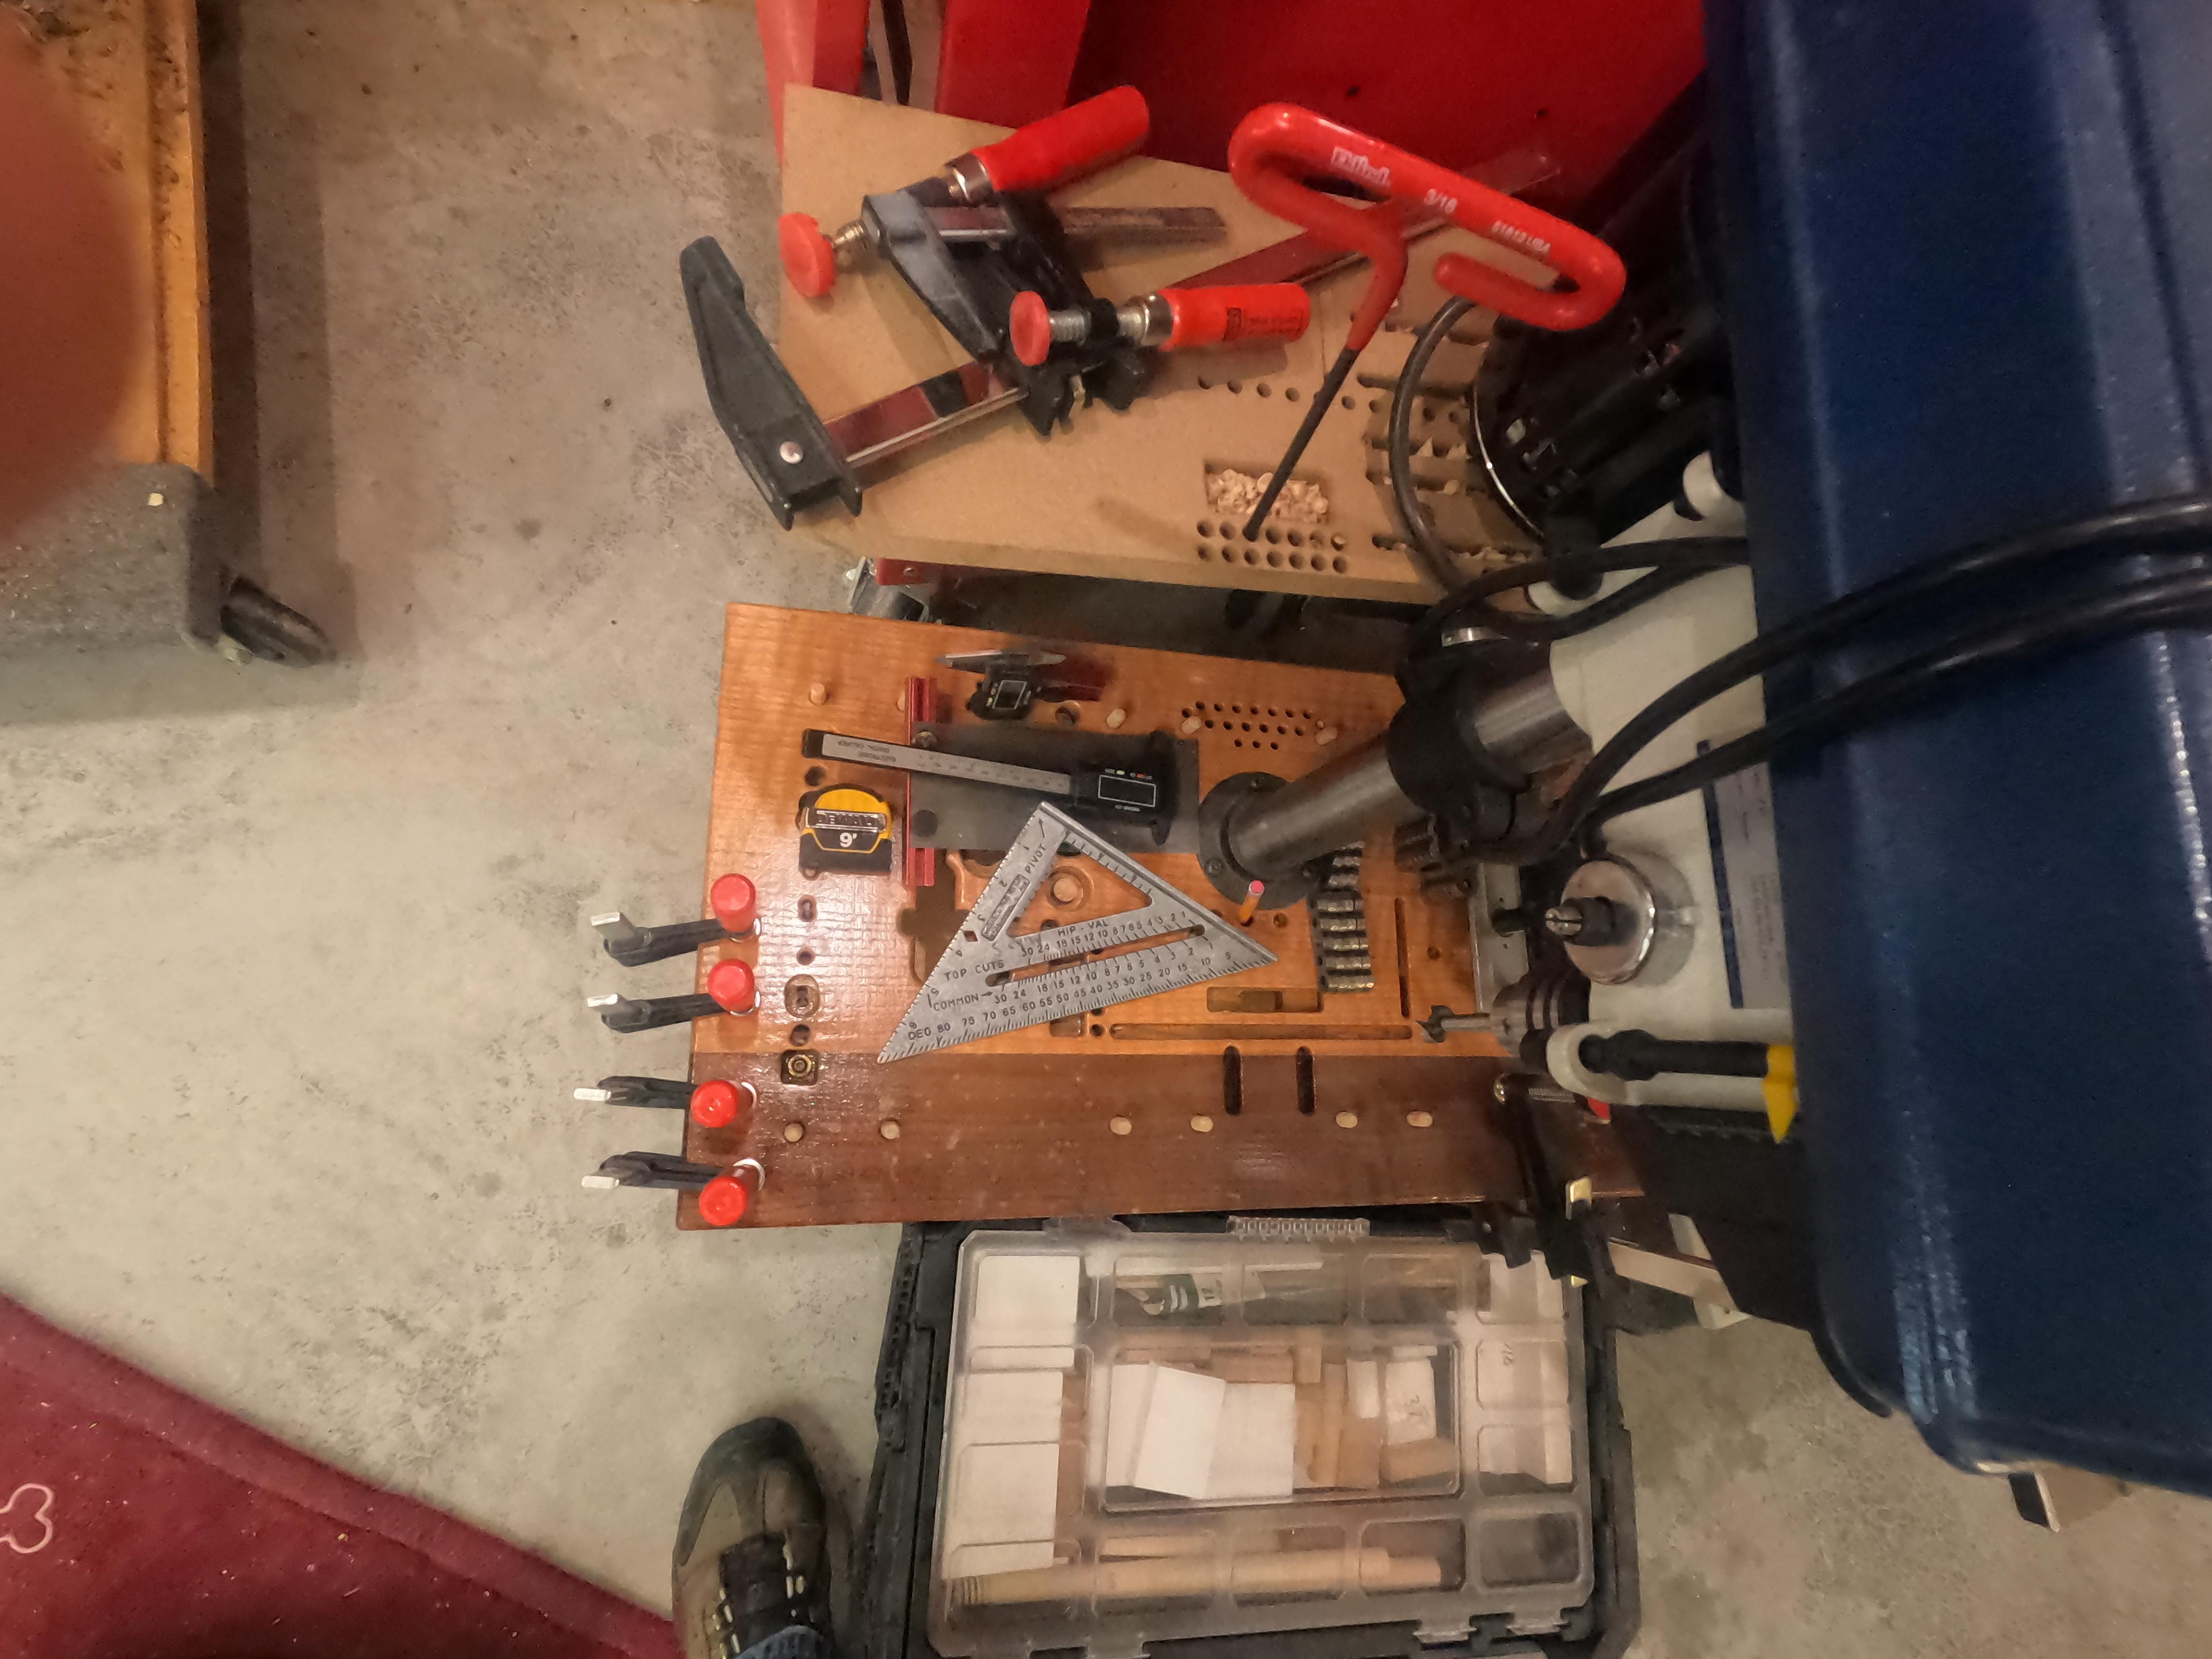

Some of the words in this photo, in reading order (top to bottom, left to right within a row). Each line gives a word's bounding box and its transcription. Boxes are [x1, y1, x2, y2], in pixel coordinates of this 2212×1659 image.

[1025, 843, 1046, 874] PIVOT
[1056, 939, 1068, 949] 18
[1070, 936, 1081, 945] 15
[1083, 932, 1095, 941] 12
[1097, 929, 1108, 938] 10
[1171, 913, 1176, 922] 2
[1058, 926, 1076, 937] HIP
[1087, 919, 1109, 929] VAL
[933, 993, 979, 1011] COMMON
[1013, 989, 1026, 999] 24
[1037, 983, 1048, 994] 18
[1053, 979, 1064, 989] 15
[1070, 975, 1080, 985] 12
[1087, 972, 1097, 981] 10
[1115, 965, 1120, 974] 7
[1139, 959, 1144, 968] 5
[944, 968, 967, 981] TOP
[975, 960, 1005, 973] CUTS
[937, 1022, 951, 1033] 80
[983, 1011, 996, 1022] 70
[1002, 1006, 1016, 1016] 65
[1022, 1001, 1036, 1012] 60
[1040, 996, 1053, 1007] 55
[1090, 984, 1103, 994] 40
[1107, 980, 1119, 991] 35
[1123, 976, 1135, 986] 30
[1140, 972, 1152, 982] 25
[1159, 968, 1170, 977] 20
[1177, 963, 1187, 972] 15
[1201, 957, 1211, 966] 10
